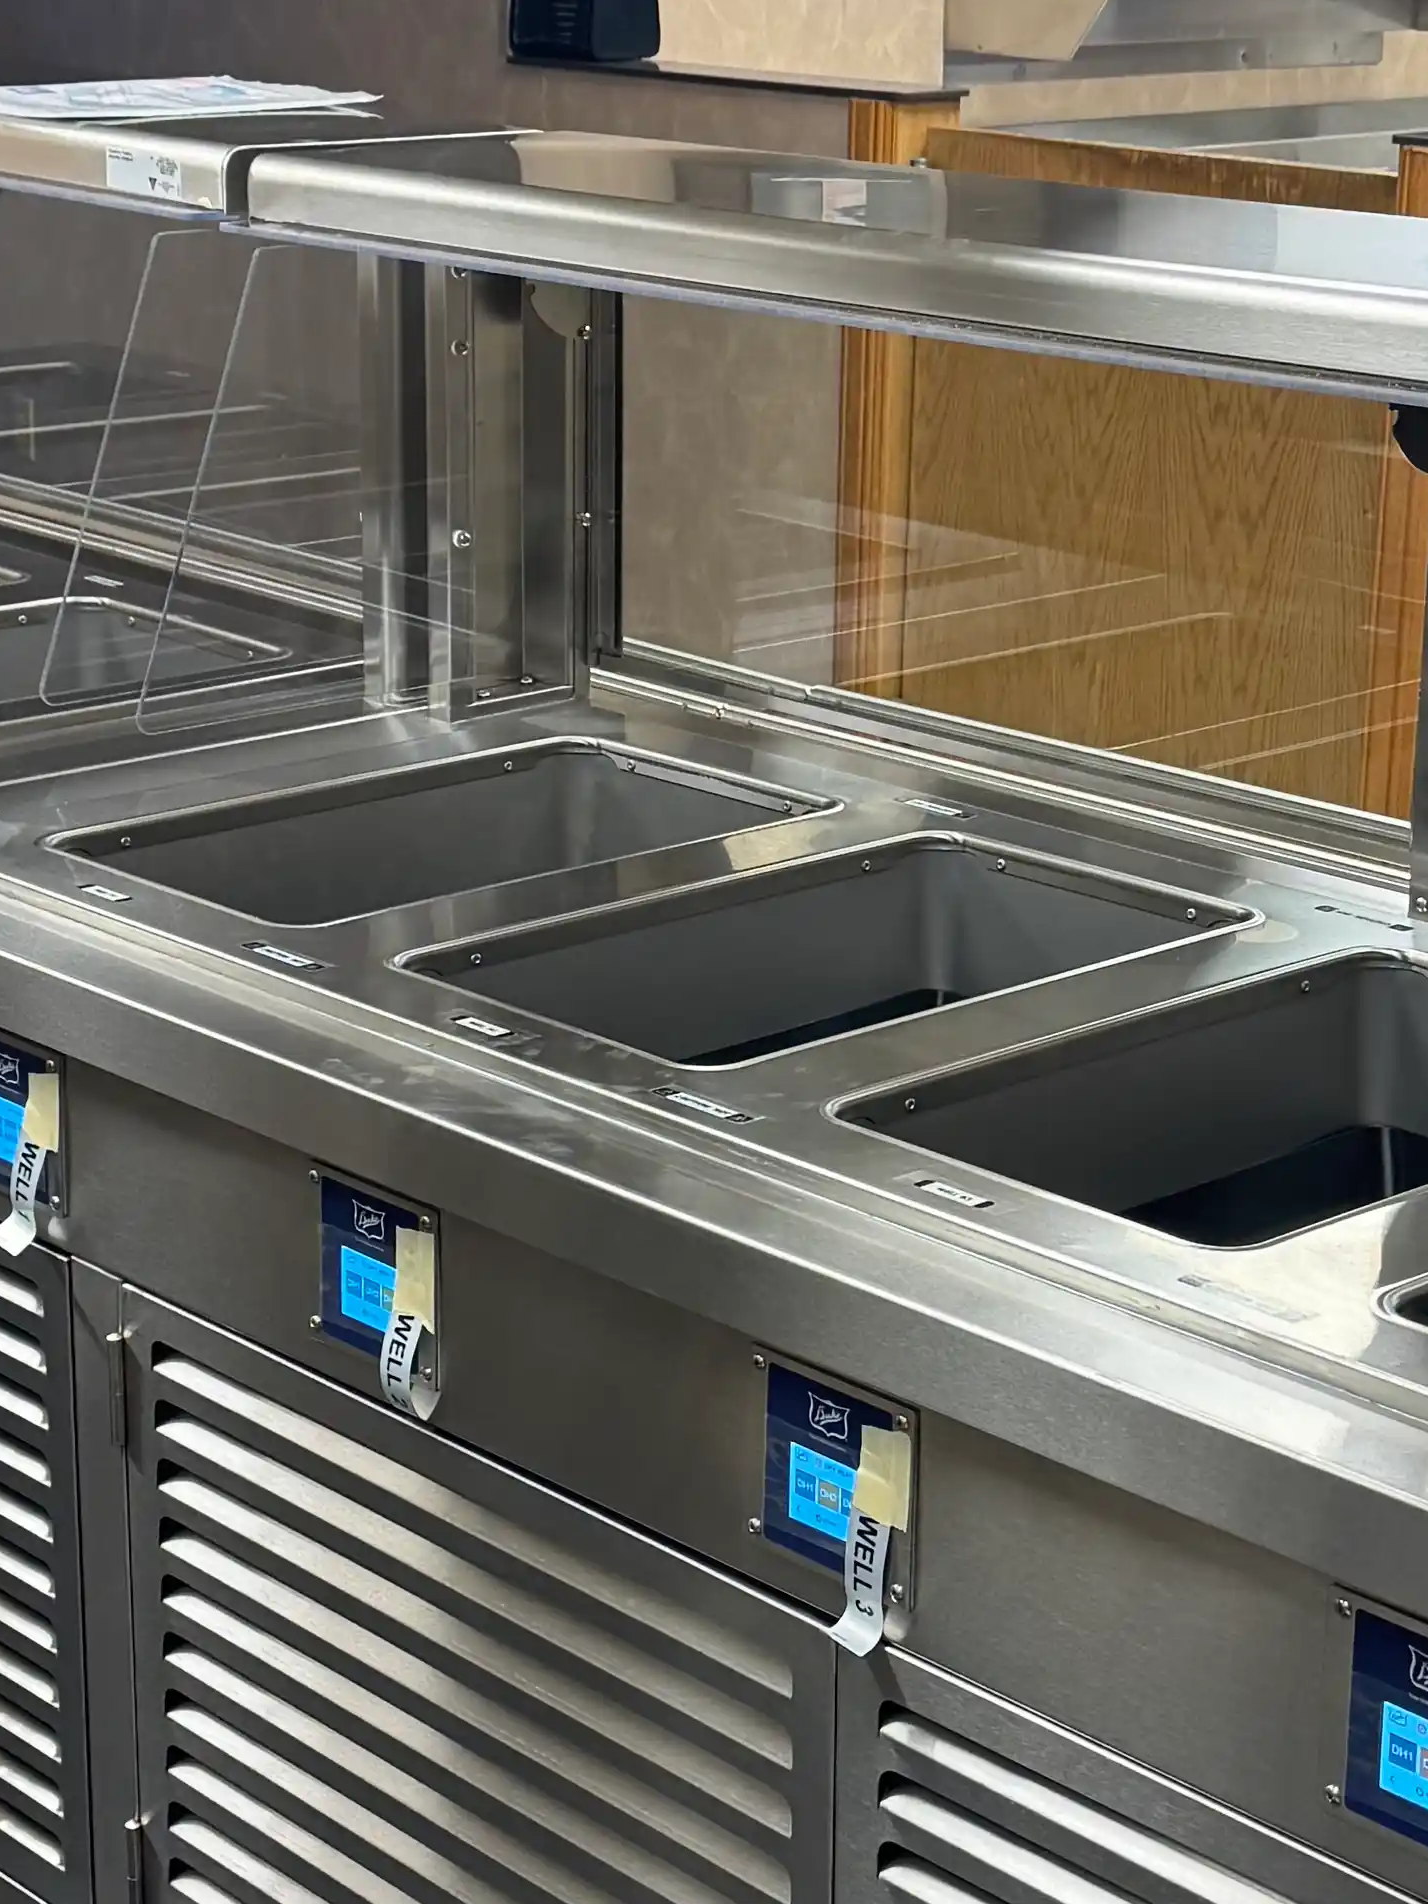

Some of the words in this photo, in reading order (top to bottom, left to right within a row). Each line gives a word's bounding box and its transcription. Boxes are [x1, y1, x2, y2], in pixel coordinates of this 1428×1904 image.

[16, 1142, 40, 1201] WELL
[387, 1314, 415, 1386] WELL
[814, 1405, 842, 1425] Duke
[853, 1516, 880, 1591] WELL
[855, 1599, 874, 1616] 3
[1391, 1743, 1413, 1761] DH1
